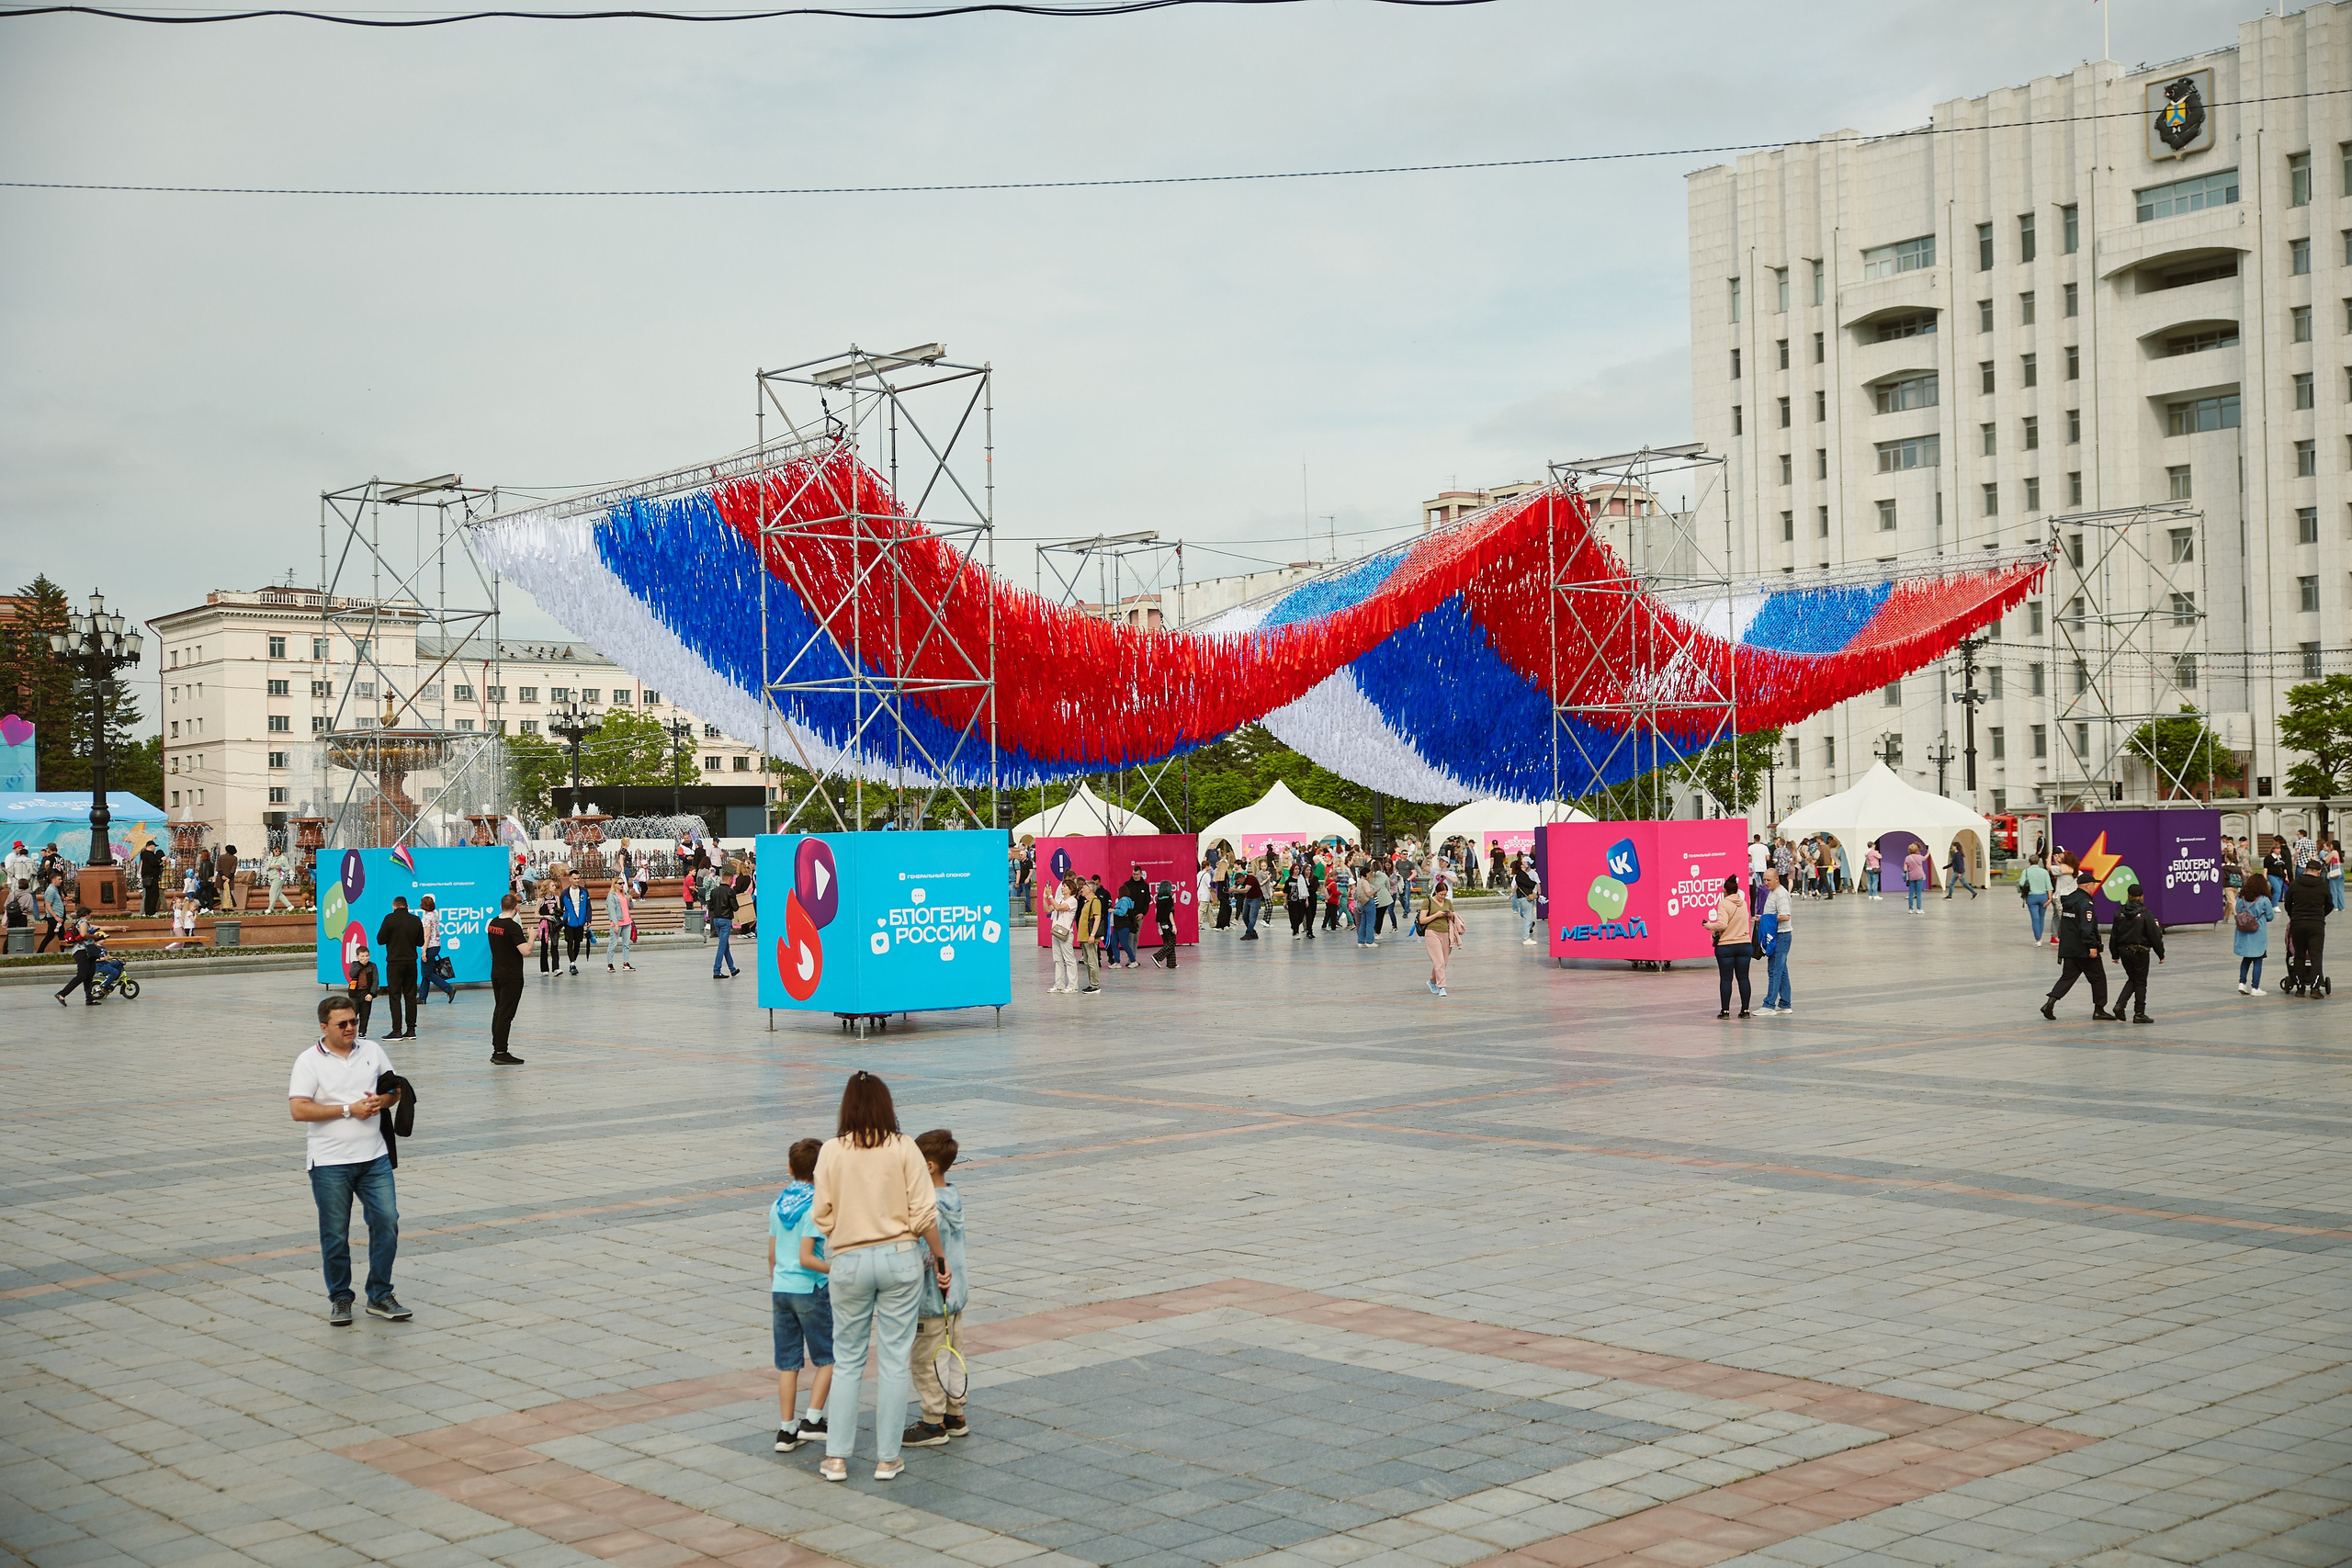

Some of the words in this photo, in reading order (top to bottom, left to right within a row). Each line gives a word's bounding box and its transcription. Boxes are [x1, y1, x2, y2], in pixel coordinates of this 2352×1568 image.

[2173, 858, 2211, 871] БЛОГЕРЫ
[2176, 870, 2210, 883] РОССИИ
[1678, 877, 1725, 894] БЛОГЕР
[889, 905, 981, 926] БЛОГЕРЫ
[439, 921, 479, 935] ССИИ
[896, 924, 976, 944] РОССИИ
[1561, 916, 1647, 941] МЕЧТАЙ
